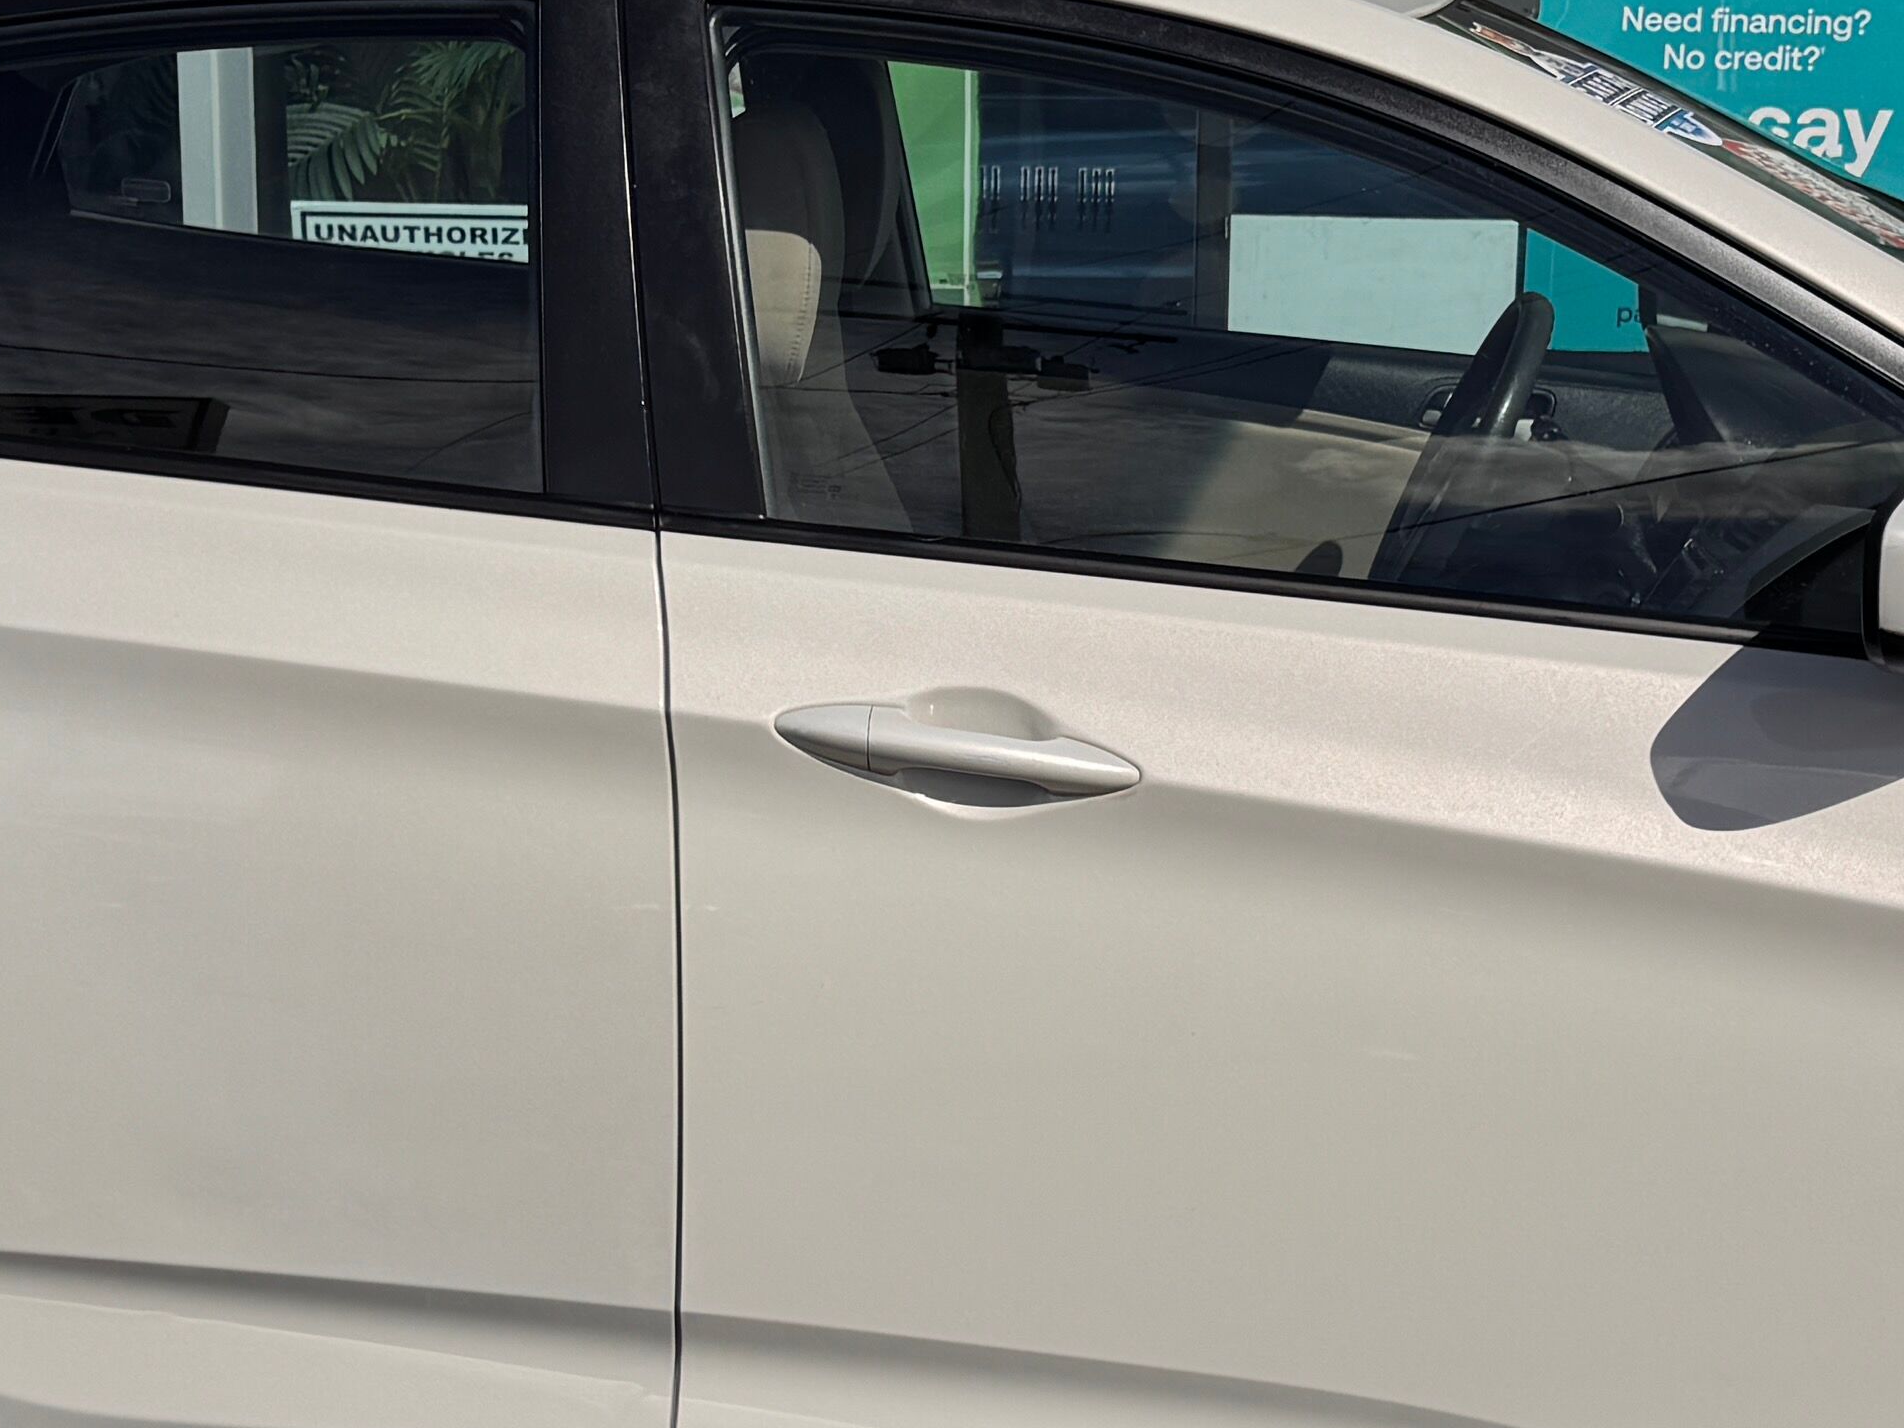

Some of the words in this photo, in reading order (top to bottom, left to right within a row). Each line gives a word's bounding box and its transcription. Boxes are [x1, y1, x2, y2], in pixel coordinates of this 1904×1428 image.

[1621, 6, 1703, 33] Need
[1711, 7, 1872, 42] financing?
[1663, 43, 1705, 70] No
